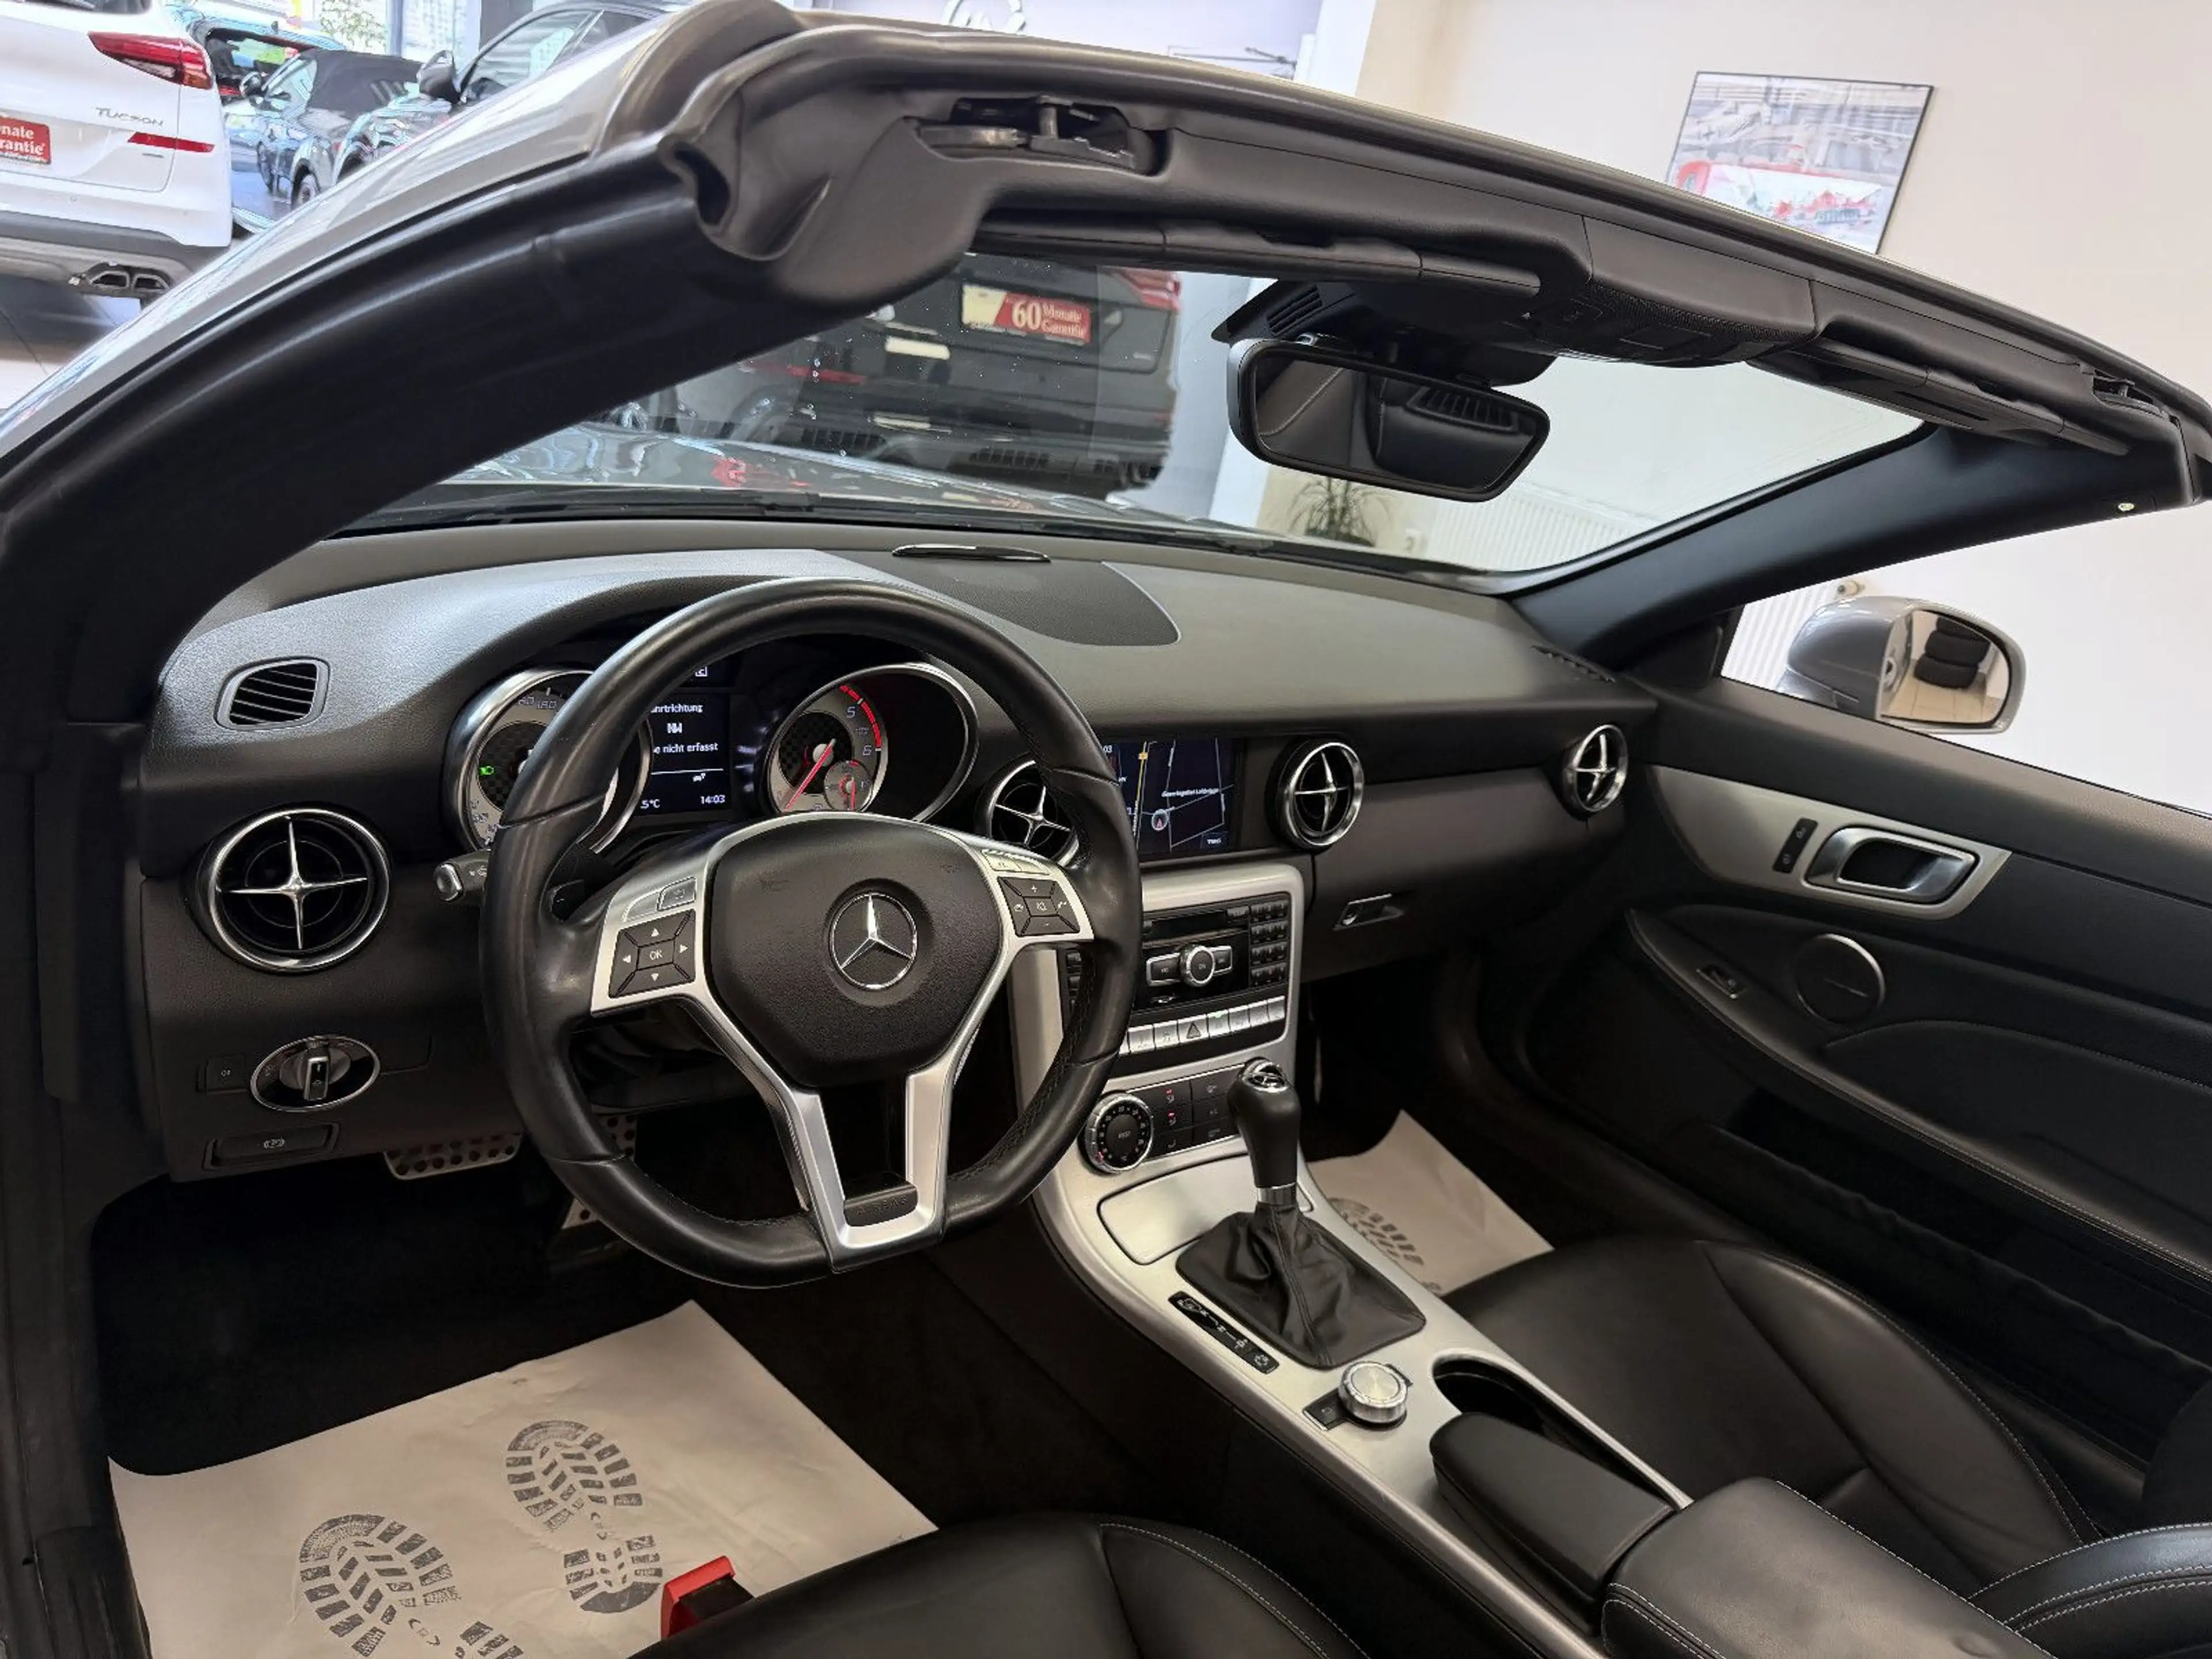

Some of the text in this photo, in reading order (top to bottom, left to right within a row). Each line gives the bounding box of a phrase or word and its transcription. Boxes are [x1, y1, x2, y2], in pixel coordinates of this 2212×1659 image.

[96, 107, 164, 126] TUCSON
[1012, 299, 1042, 331] 60
[846, 706, 855, 718] 5
[663, 744, 684, 753] nicht
[687, 742, 718, 752] erfasst
[863, 745, 872, 756] 6
[700, 795, 725, 804] 14:03
[650, 950, 663, 960] OK
